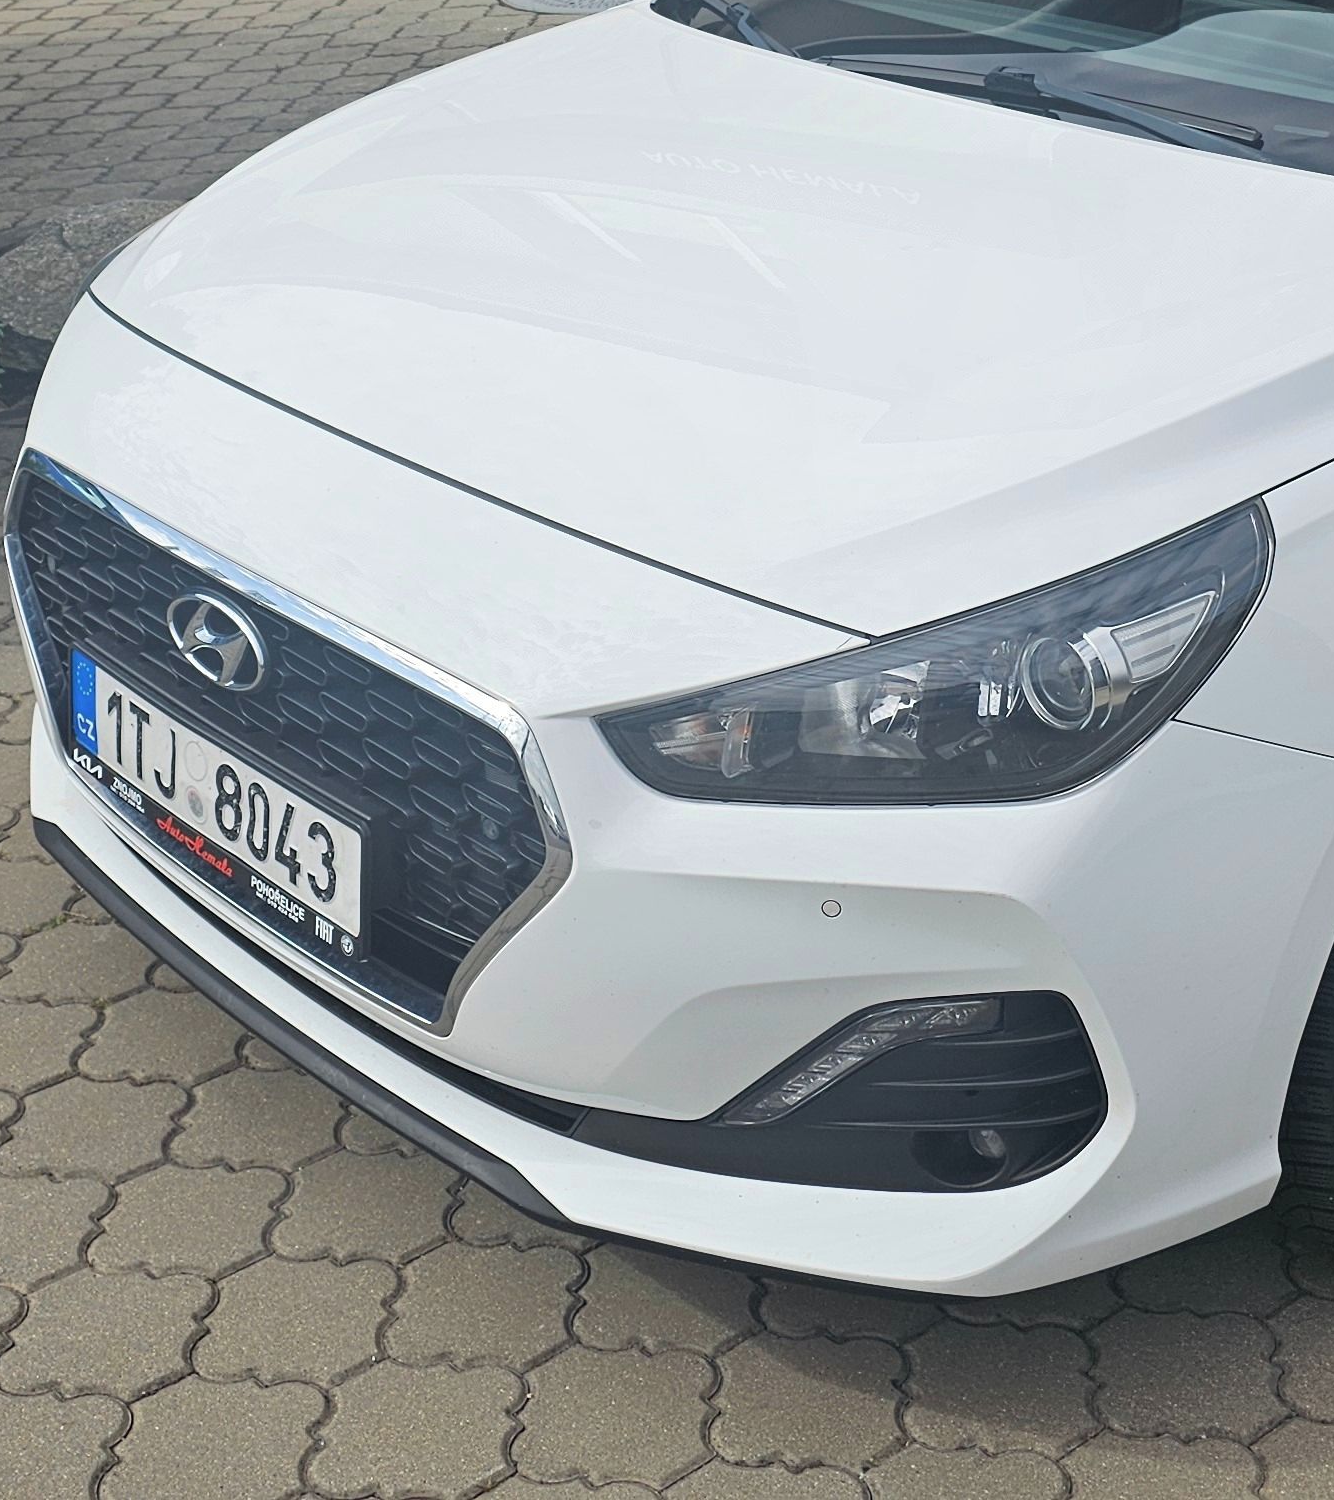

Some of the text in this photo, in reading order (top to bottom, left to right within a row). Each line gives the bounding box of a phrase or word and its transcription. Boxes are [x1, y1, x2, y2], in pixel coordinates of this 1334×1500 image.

[77, 712, 96, 741] CZ
[73, 748, 103, 779] KIA
[107, 690, 337, 903] 1TJ 8043
[250, 875, 305, 922] POHOŘELICE
[315, 915, 335, 945] FIAT
